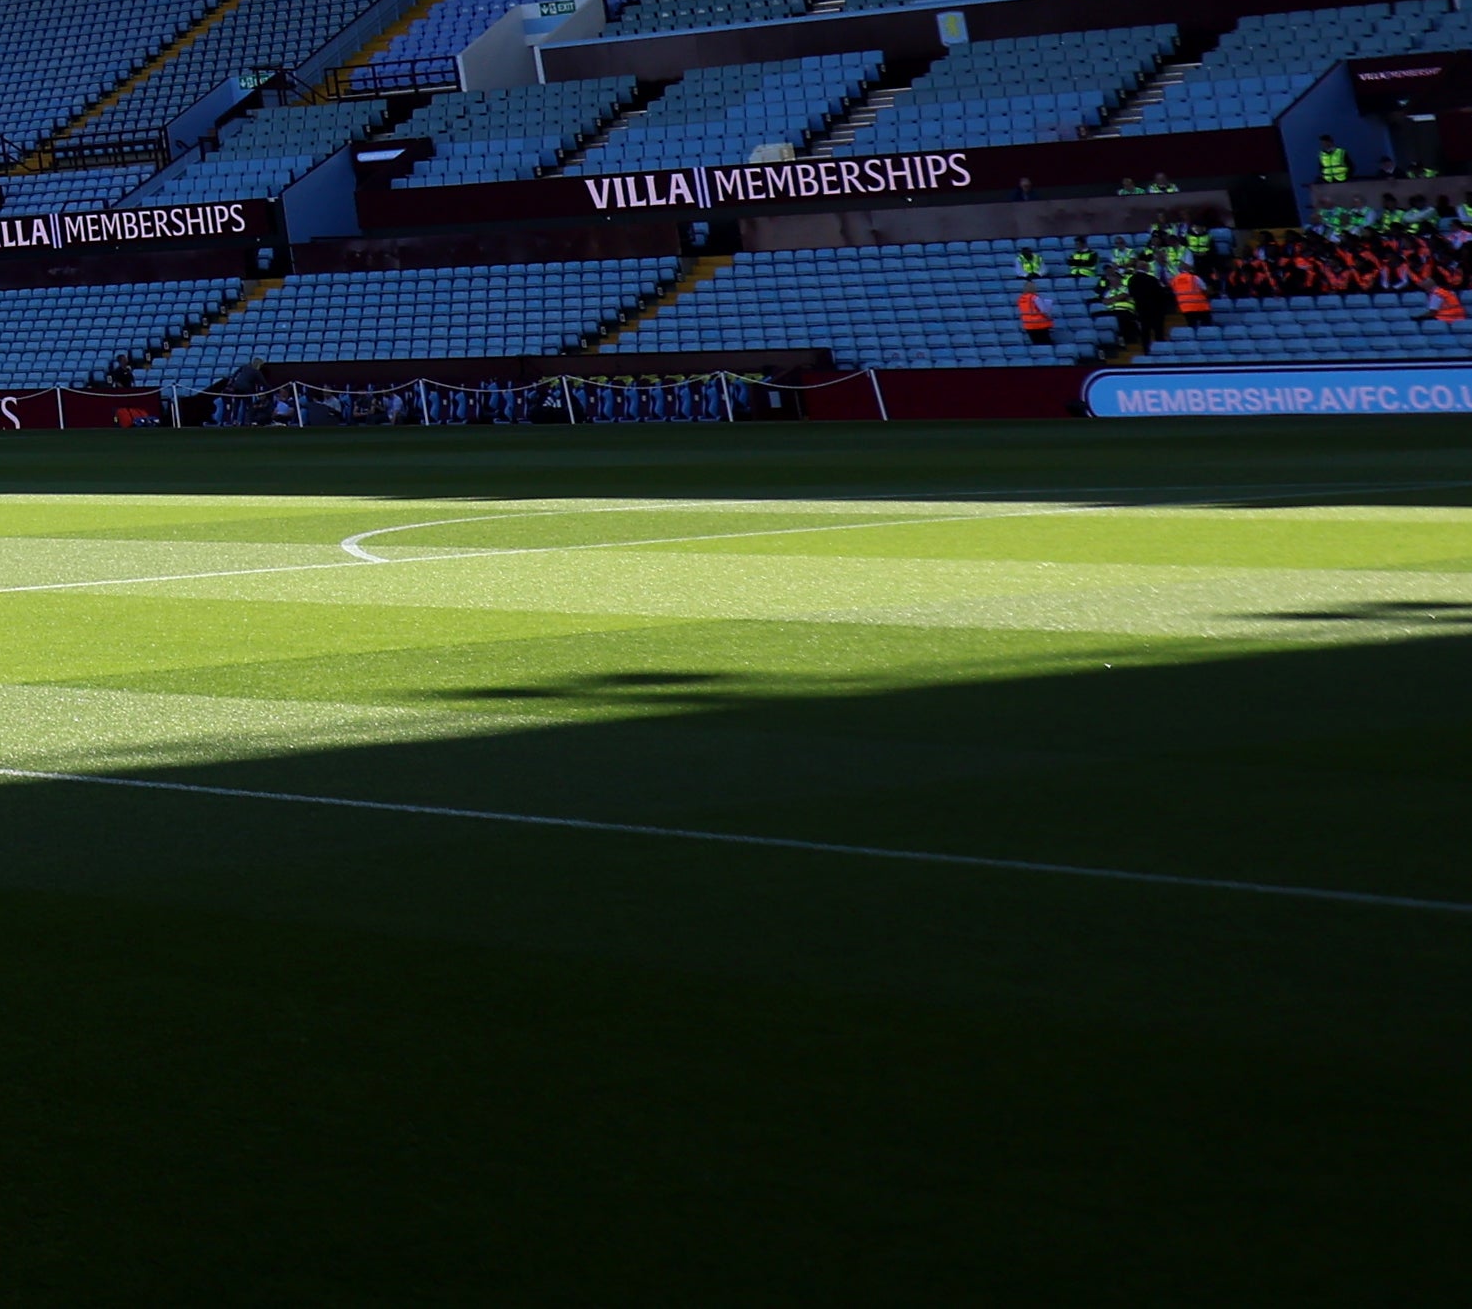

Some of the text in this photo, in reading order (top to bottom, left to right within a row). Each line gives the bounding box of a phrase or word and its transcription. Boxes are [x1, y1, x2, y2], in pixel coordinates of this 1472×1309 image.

[557, 1, 575, 13] EXIT
[585, 153, 972, 209] VILLA MEMBERSHIPS
[64, 204, 246, 243] MEMBERSHIPS
